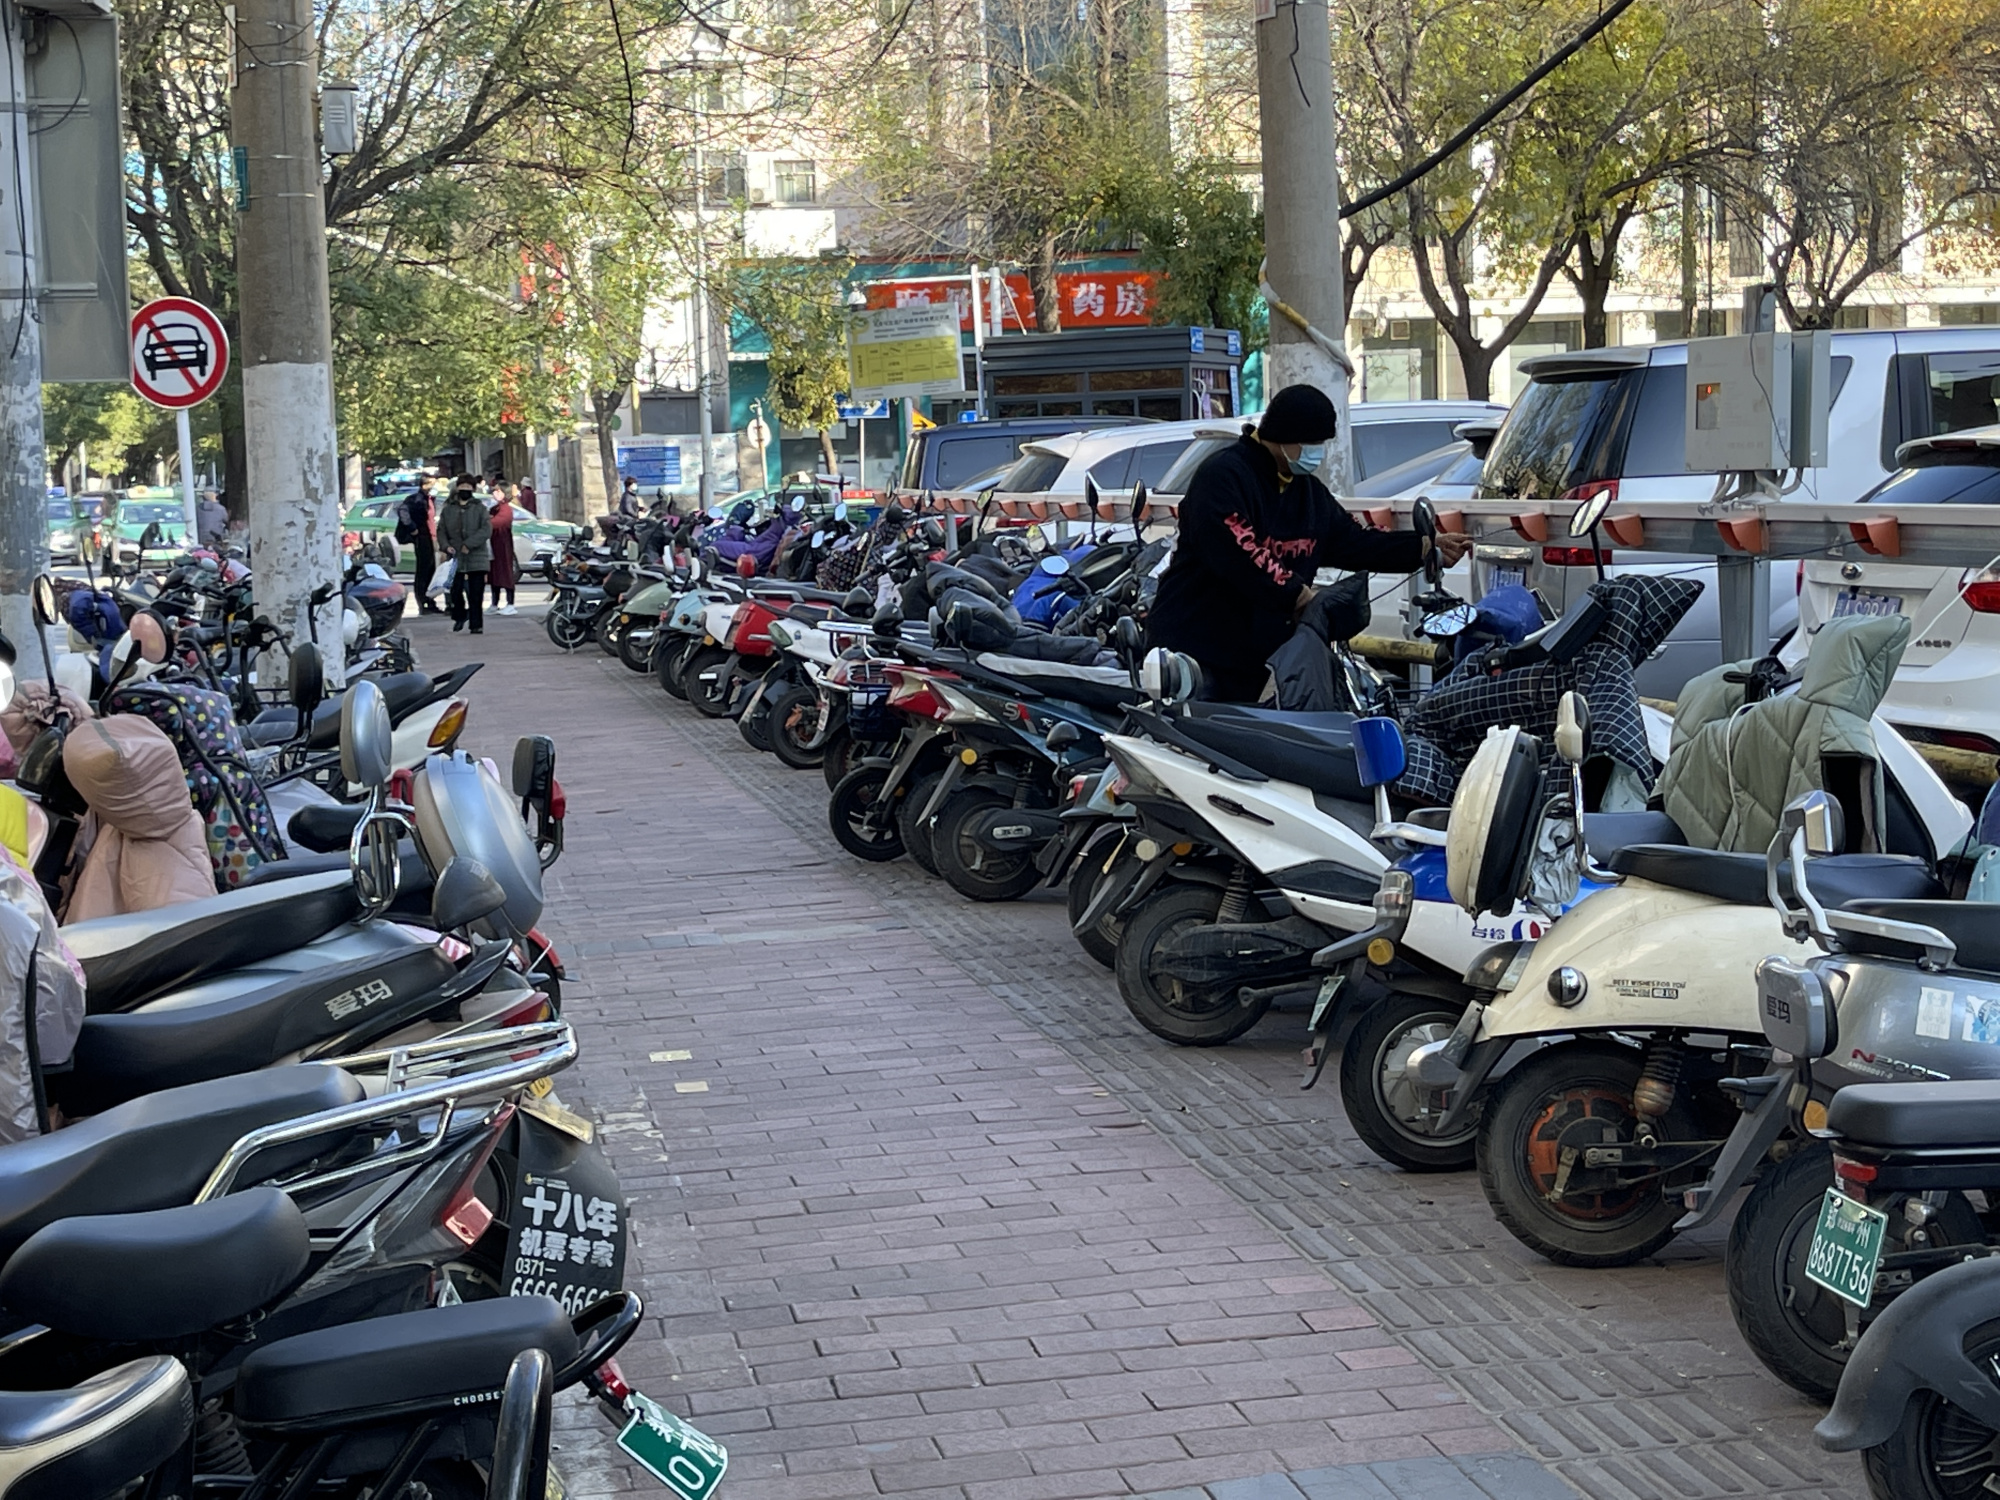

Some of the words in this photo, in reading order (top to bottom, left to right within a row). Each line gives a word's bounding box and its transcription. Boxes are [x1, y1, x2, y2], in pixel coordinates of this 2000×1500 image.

[324, 978, 393, 1021] 爱玛
[1766, 994, 1790, 1024] 爱玛
[522, 1186, 618, 1238] 十八年
[519, 1227, 615, 1268] 机票专家
[1810, 1234, 1871, 1296] 8687756
[453, 1390, 505, 1406] CHOOSE
